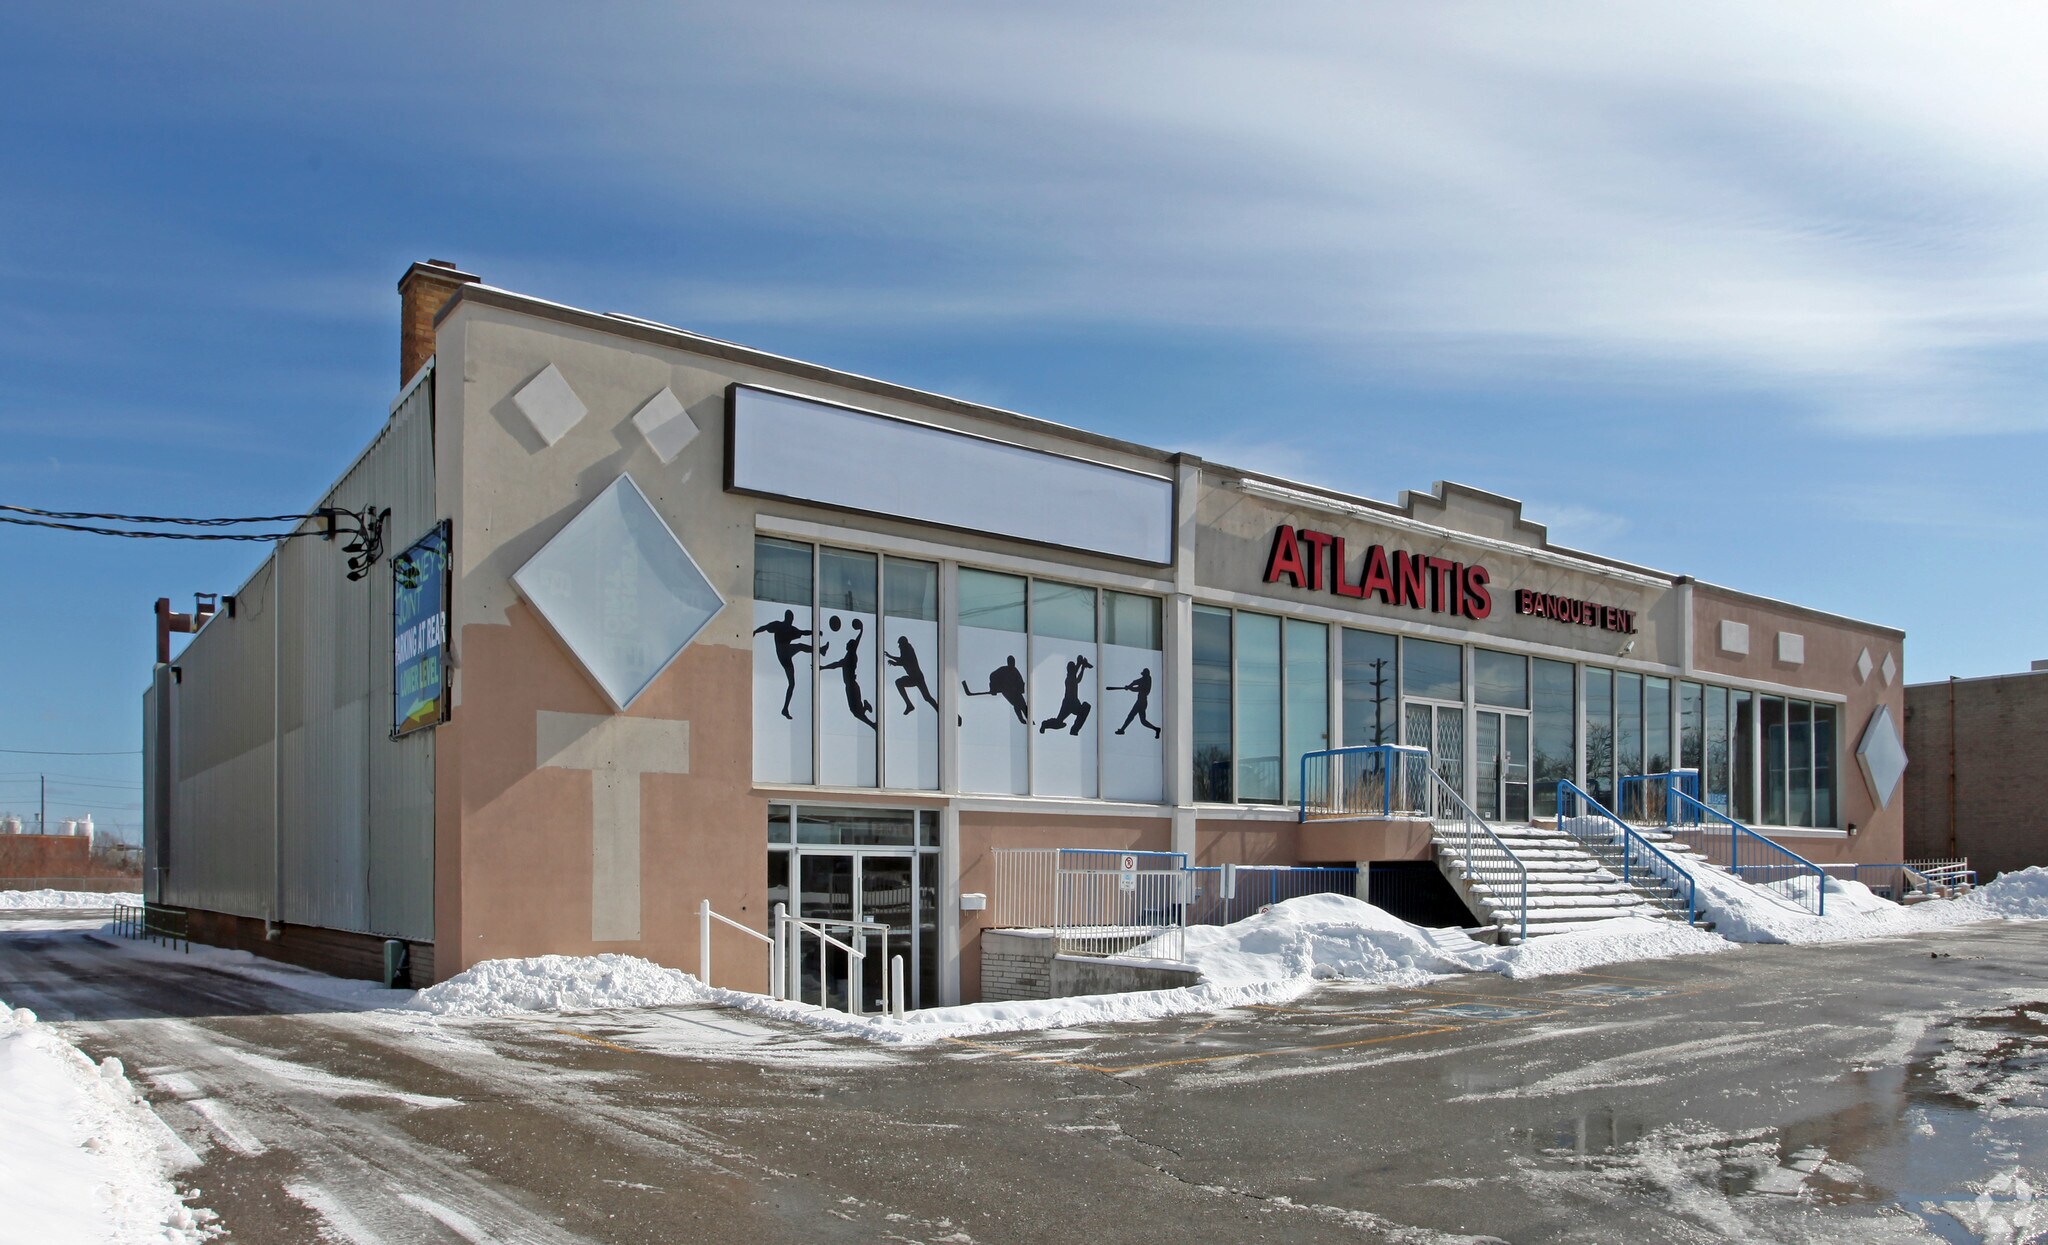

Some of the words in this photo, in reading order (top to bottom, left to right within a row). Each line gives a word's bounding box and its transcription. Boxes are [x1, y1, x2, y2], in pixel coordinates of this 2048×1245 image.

[1263, 524, 1492, 620] ATLANTIS
[1516, 589, 1601, 627] BANQUET
[1604, 605, 1638, 634] ENT.
[395, 627, 416, 664] PARKING
[418, 621, 427, 653] AT
[427, 611, 446, 647] REAR
[401, 666, 419, 695] LOWER
[420, 656, 439, 687] LEVEL
